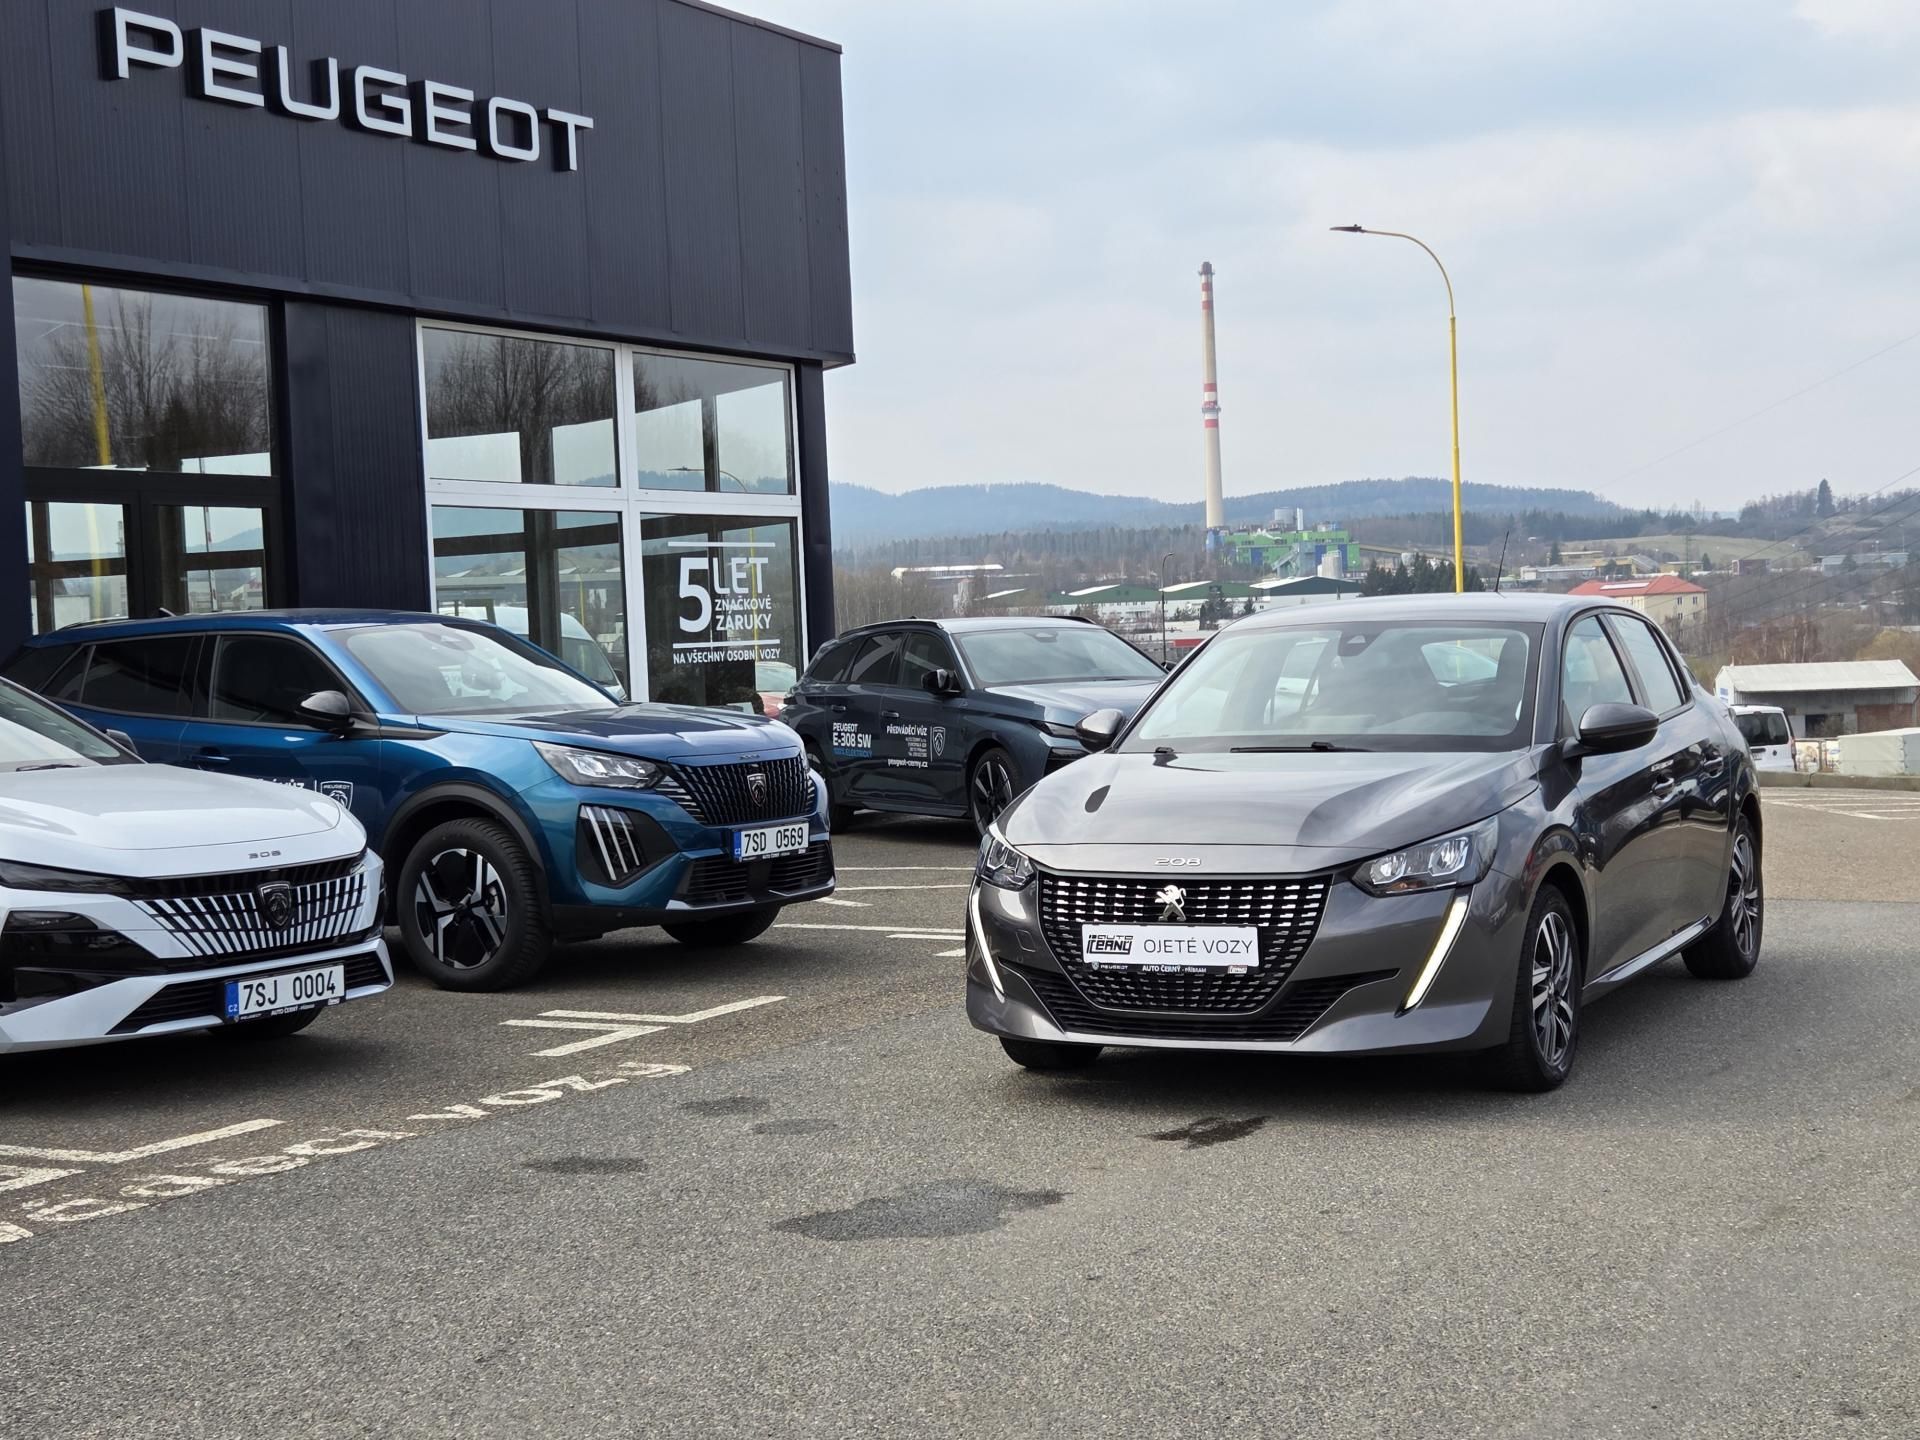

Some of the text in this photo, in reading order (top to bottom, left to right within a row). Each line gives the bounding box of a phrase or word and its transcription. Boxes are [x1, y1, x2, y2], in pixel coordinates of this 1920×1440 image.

[112, 6, 594, 171] PEUGEOT
[679, 557, 768, 632] 5 LET
[715, 594, 772, 611] ZNAČKOVÉ
[715, 610, 772, 631] ZÁRUKY
[673, 653, 686, 665] NA
[687, 650, 725, 663] VŠECHNY
[760, 648, 781, 659] VOZY
[833, 722, 858, 732] PEUGEOT
[833, 732, 872, 748] E-308 SW
[744, 827, 804, 854] 7SD 0569
[1154, 857, 1201, 867] 208
[1143, 937, 1252, 954] OJETÉ VOZY
[1160, 964, 1181, 973] ČERNÝ
[243, 970, 335, 1010] 7SJ 0004
[228, 1004, 238, 1013] CZ
